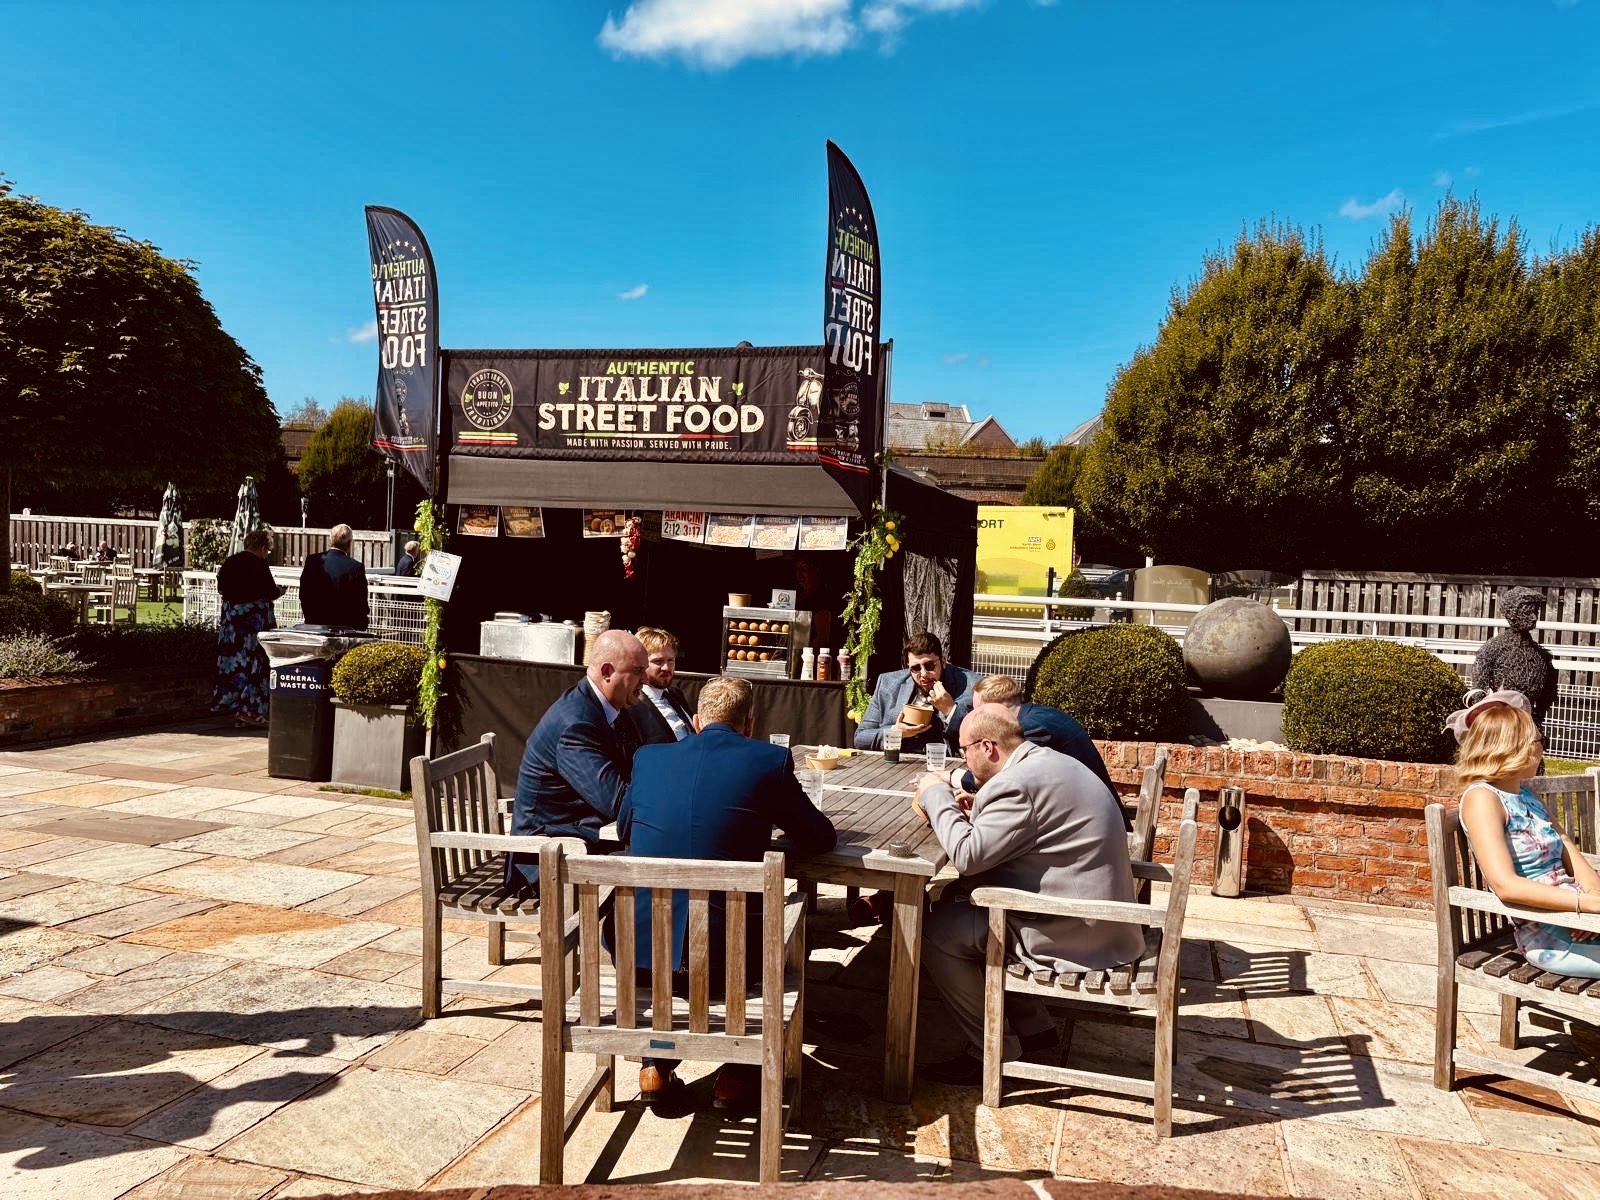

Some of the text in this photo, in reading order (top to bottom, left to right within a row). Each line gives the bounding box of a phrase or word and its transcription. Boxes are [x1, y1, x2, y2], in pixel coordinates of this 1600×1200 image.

[606, 361, 695, 375] AUTHENTIC
[477, 391, 498, 400] BUON
[578, 376, 722, 403] ITALIAN
[538, 402, 764, 434] STREET FOOD
[566, 438, 732, 450] MADE WITH PASSION. SERVED WITH PRIDE.
[664, 511, 703, 525] ARANCINI
[977, 519, 1004, 529] ORT
[280, 674, 317, 682] GENERAL
[280, 682, 307, 690] WASTE
